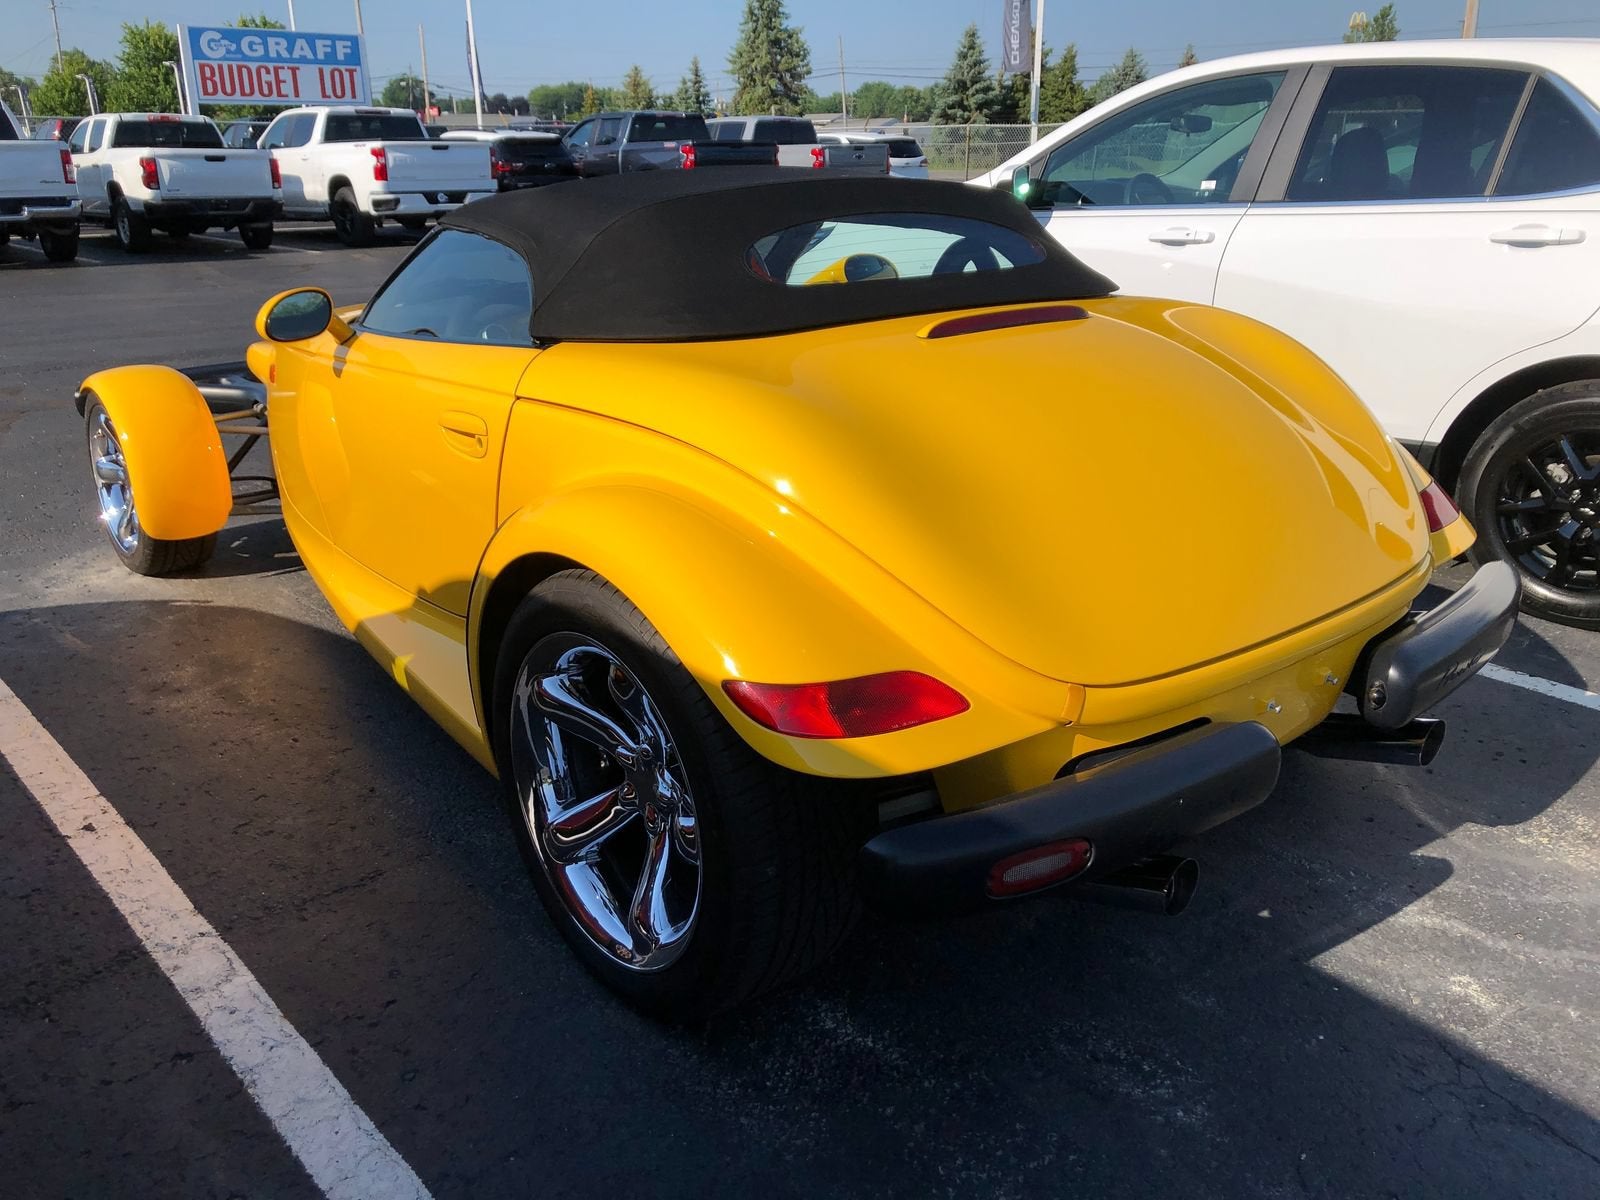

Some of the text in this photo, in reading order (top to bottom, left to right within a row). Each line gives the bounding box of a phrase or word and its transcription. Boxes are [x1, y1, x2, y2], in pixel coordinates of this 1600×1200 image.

[240, 35, 352, 61] GRAFF
[1011, 0, 1021, 65] CHEVRO
[198, 62, 357, 99] BUDGET LOT
